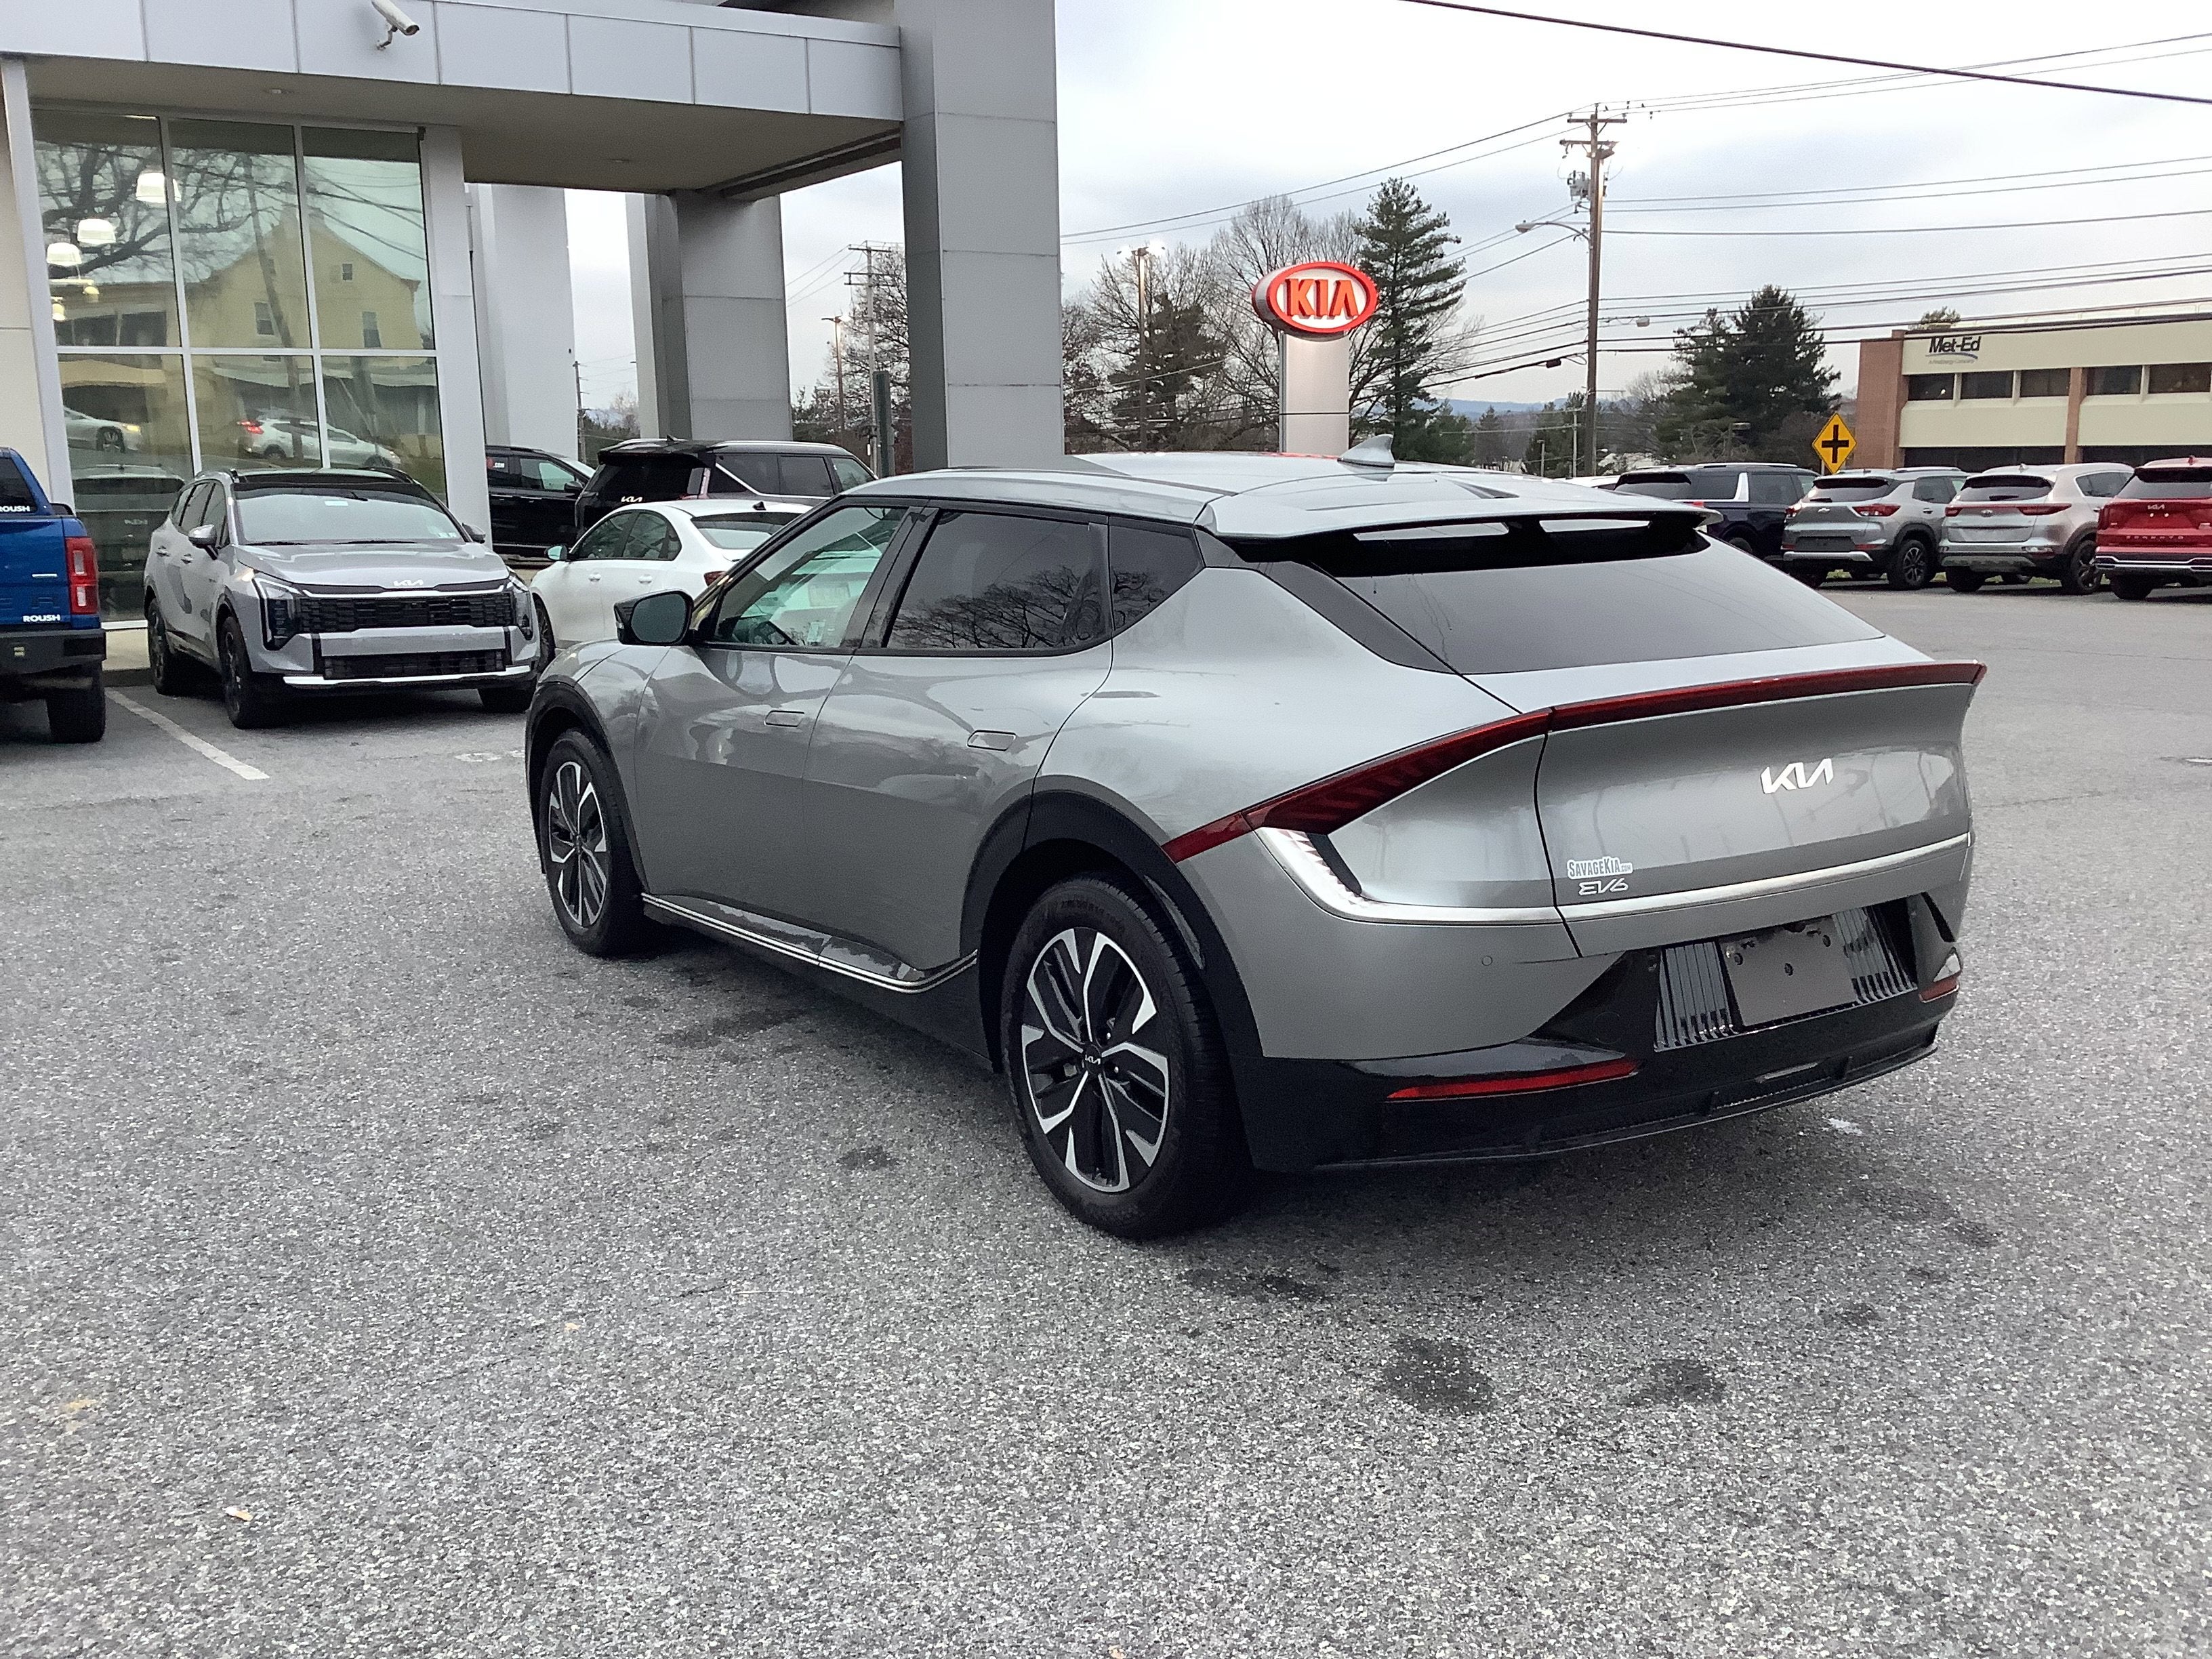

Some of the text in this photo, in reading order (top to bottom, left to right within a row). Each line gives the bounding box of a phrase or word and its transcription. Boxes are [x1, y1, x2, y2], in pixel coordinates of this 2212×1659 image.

[1286, 279, 1359, 317] KIA
[1929, 336, 1982, 353] Met-Ed
[22, 614, 61, 622] ROUSH
[1760, 758, 1834, 794] KIA
[1578, 878, 1629, 896] EV6
